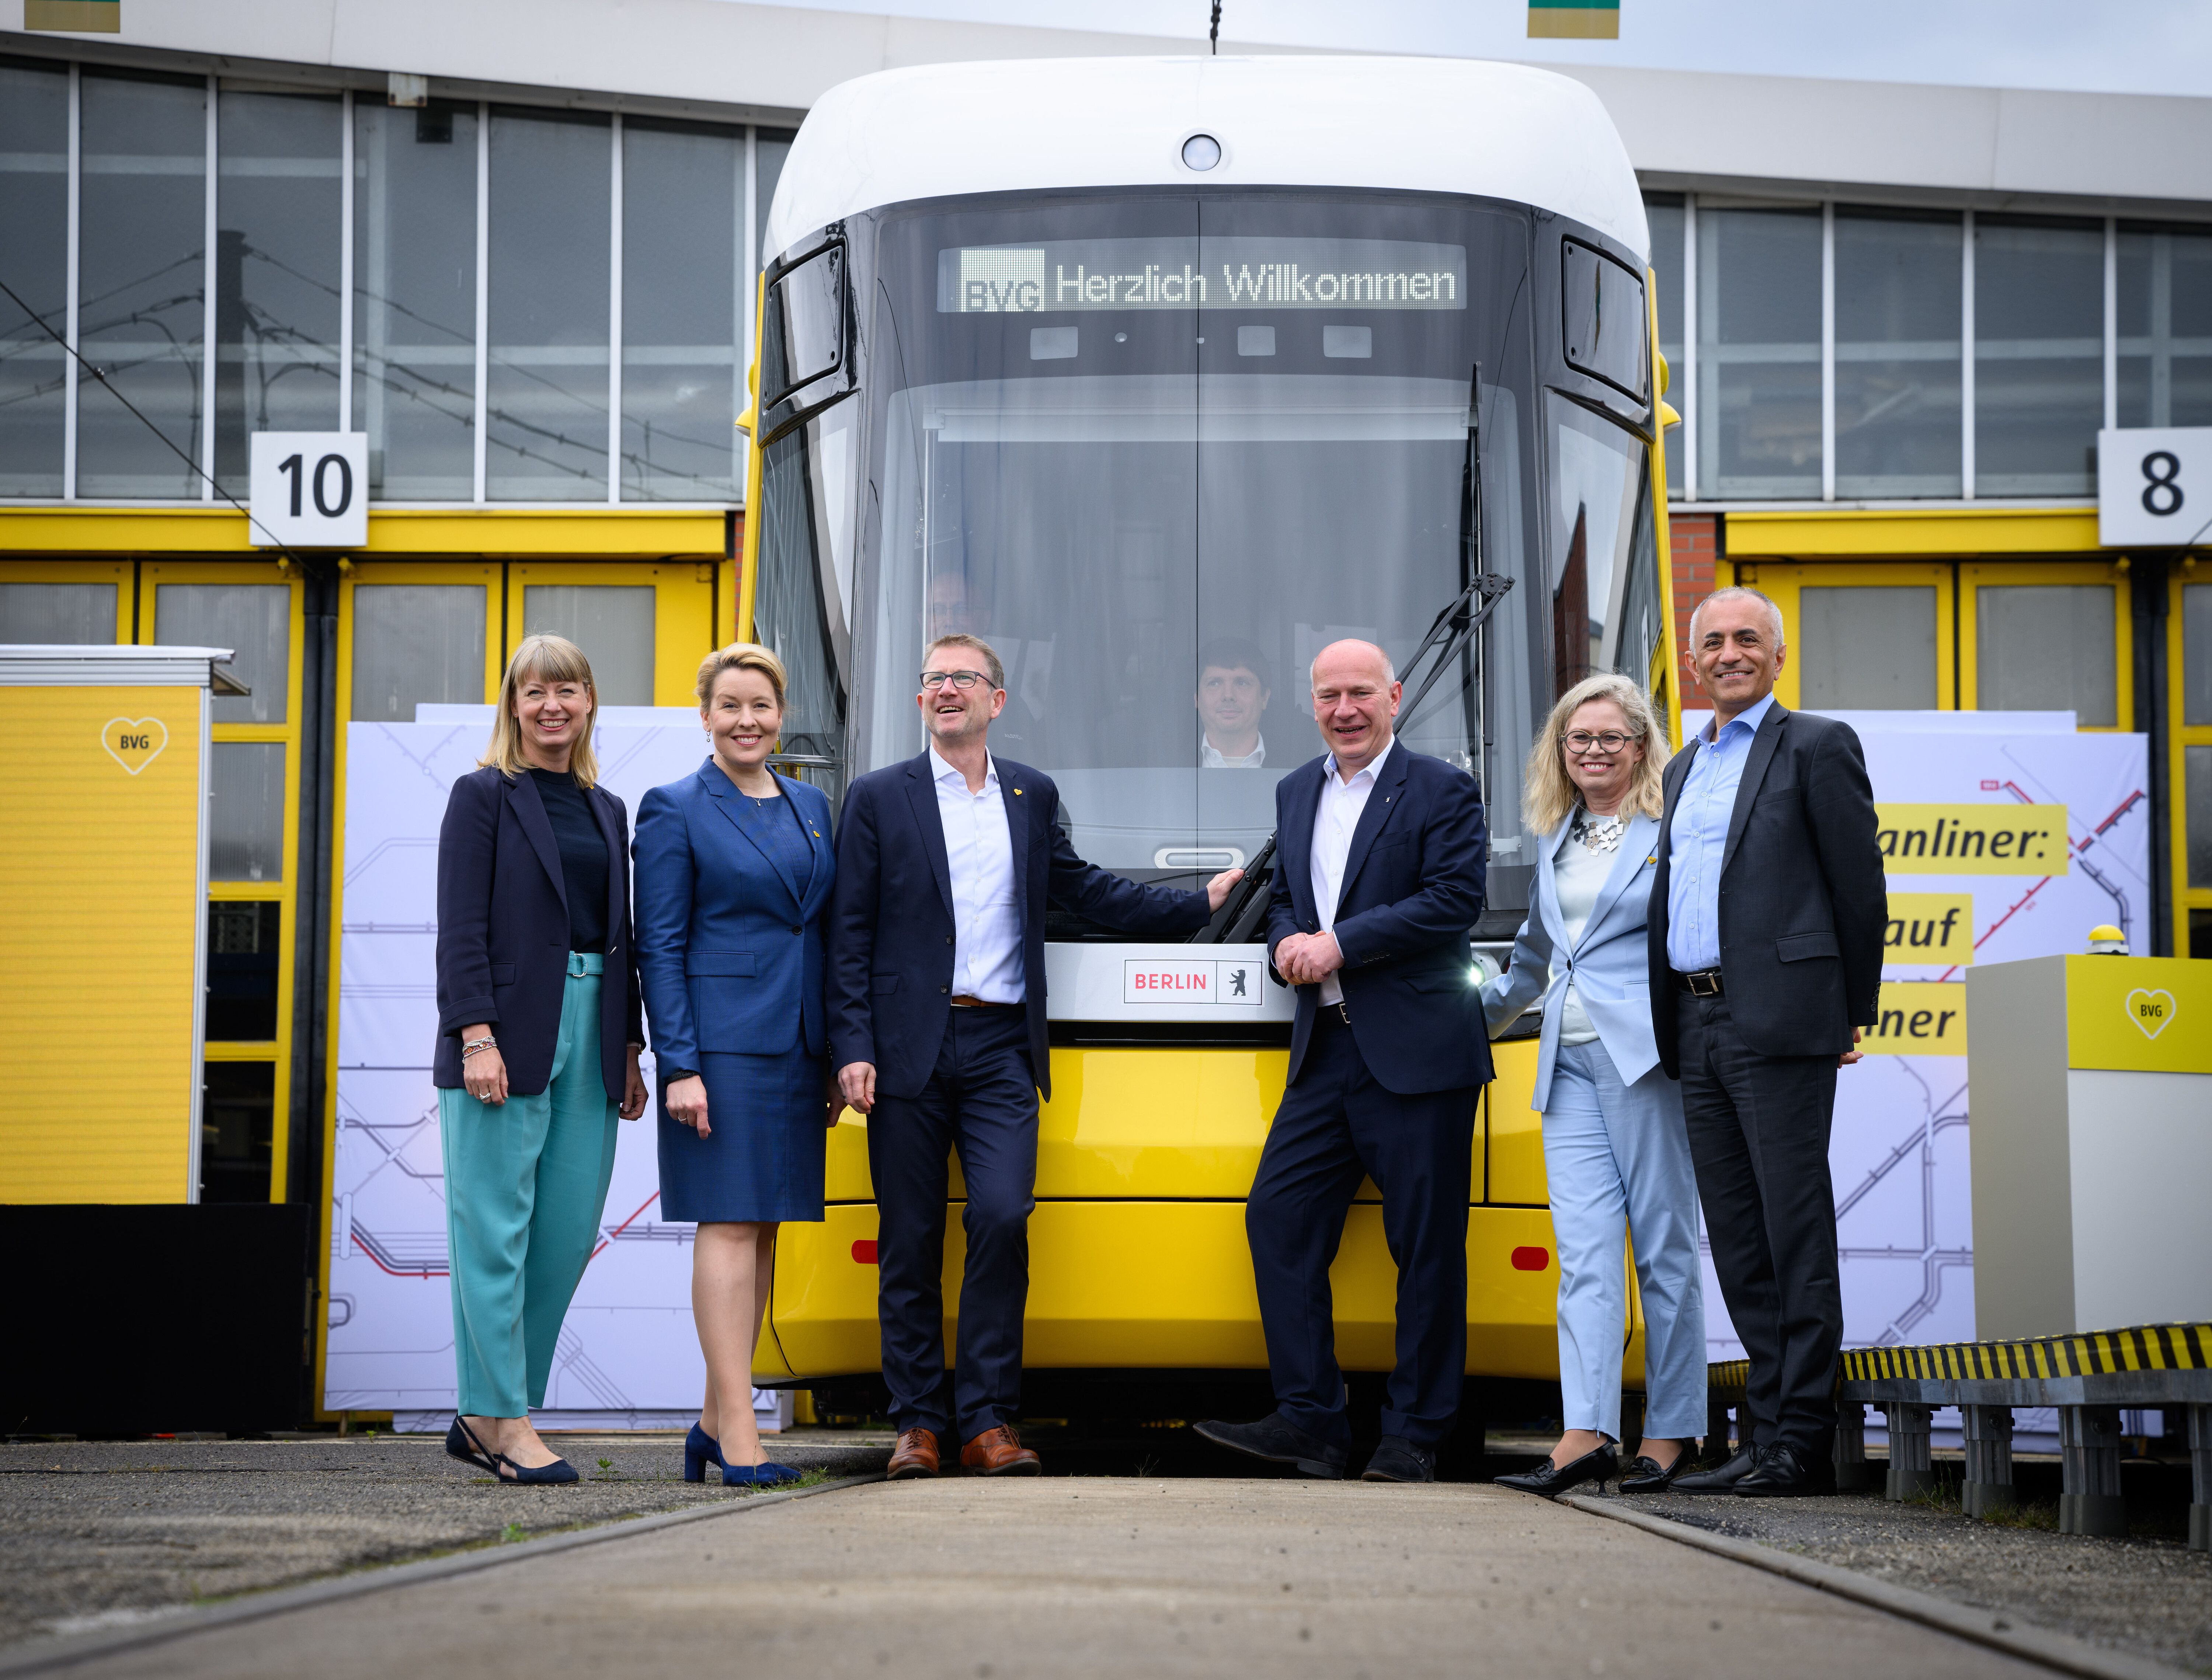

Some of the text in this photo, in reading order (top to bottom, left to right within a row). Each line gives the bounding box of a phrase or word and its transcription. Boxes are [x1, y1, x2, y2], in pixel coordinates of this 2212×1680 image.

[966, 279, 1040, 312] BVG
[1057, 264, 1455, 302] Herzlich Willkommen
[278, 454, 352, 517] 10
[2141, 451, 2184, 516] 8
[120, 735, 149, 750] BVG
[1135, 973, 1206, 989] BERLIN
[2140, 1004, 2162, 1017] BVG
